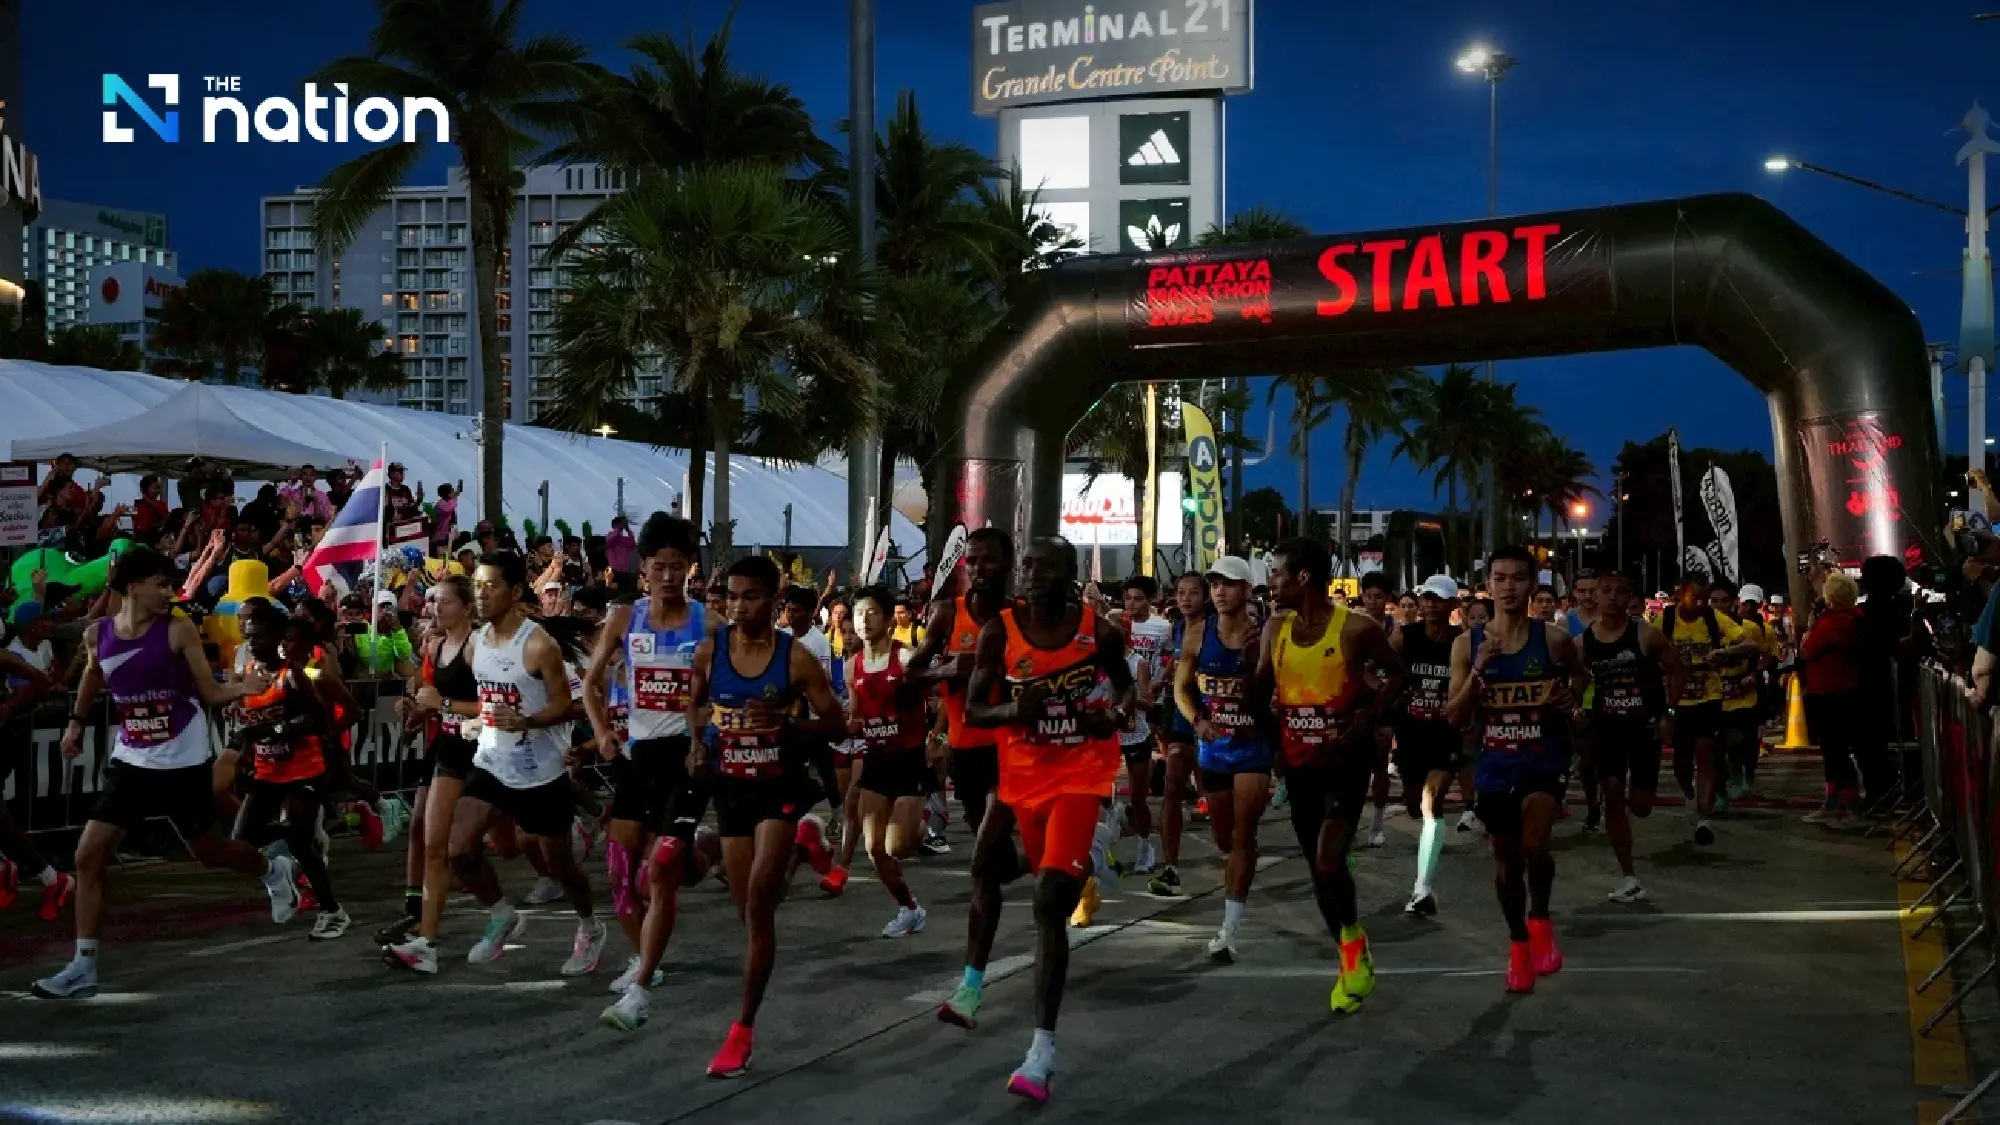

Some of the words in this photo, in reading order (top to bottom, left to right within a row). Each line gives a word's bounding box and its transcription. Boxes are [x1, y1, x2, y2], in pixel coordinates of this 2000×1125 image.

[982, 66, 1066, 99] Grande
[1068, 55, 1146, 89] Centre
[1148, 48, 1229, 83] Point
[1149, 259, 1271, 287] PATTAYA
[1317, 224, 1560, 316] START
[1147, 281, 1271, 304] MARATHON
[639, 680, 678, 694] 20027
[125, 716, 171, 732] BENNET
[1037, 717, 1077, 734] NJAI
[1286, 716, 1325, 730] 20028
[723, 747, 781, 764] SUKSAWAT
